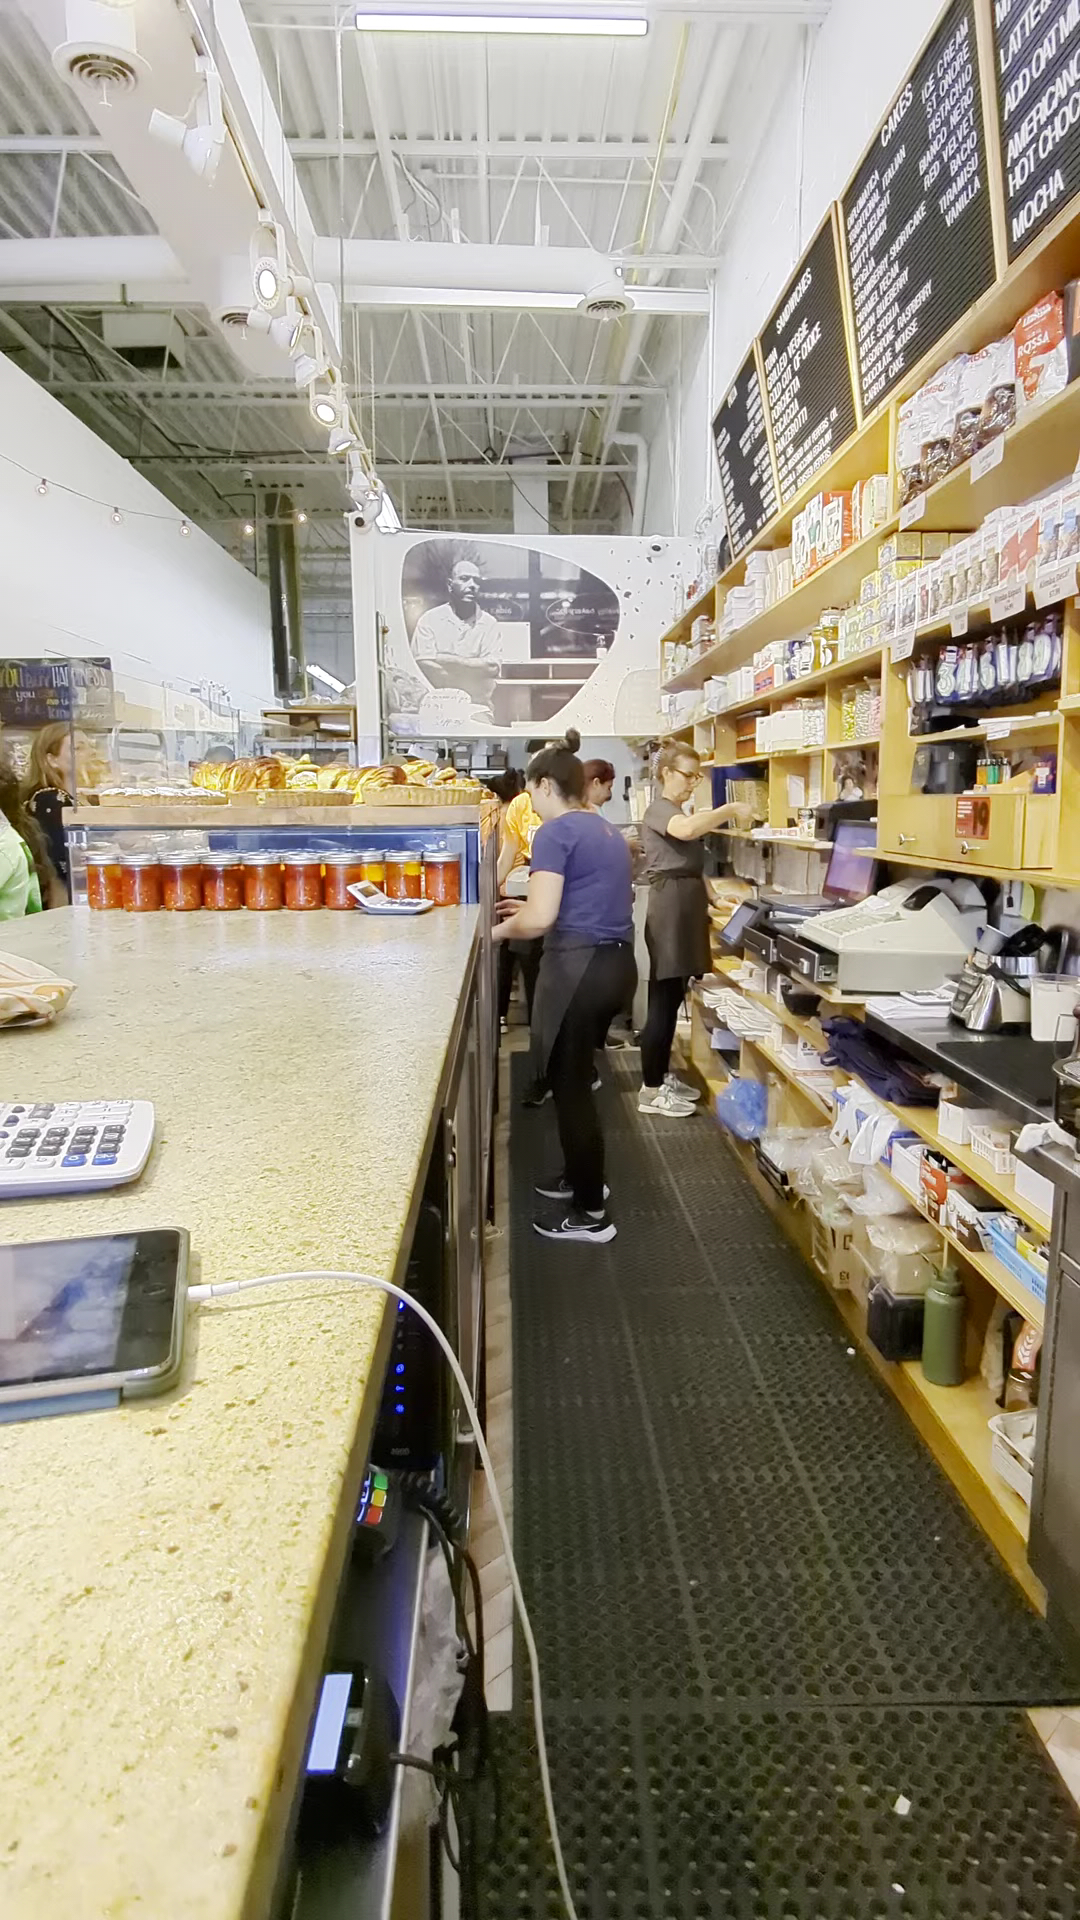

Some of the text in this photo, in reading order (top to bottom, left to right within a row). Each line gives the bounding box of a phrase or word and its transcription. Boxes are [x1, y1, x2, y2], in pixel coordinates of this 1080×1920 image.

[921, 16, 968, 103] ICE CREAM
[926, 40, 969, 118] ST ONORE
[1005, 67, 1029, 121] ADD
[1032, 23, 1058, 78] OAT
[881, 83, 912, 146] CAKES
[919, 86, 973, 175] BIANCO NERO
[928, 64, 971, 139] PISTACHIO
[882, 144, 905, 190] ITALIAN
[923, 107, 973, 190] RED VELVET
[949, 130, 976, 176] BACIO
[1009, 144, 1036, 197] HOT
[938, 152, 977, 213] TIRAMISU
[945, 175, 980, 226] VANILLA
[1013, 169, 1064, 242] MOCHA
[850, 190, 889, 262] LEMON DELIGHT
[854, 200, 926, 310] STRAWBERRY SHORTCAKE
[851, 244, 868, 278] NUTTY
[879, 260, 898, 294] PECAN
[776, 267, 811, 334] SANDWICHES
[857, 266, 908, 342] LEMON BLUEBERRY
[897, 279, 931, 330] RASPBERRY
[766, 317, 808, 390] GRILLED VEGGIE
[793, 350, 800, 371] OF
[801, 321, 821, 359] CHOICE
[859, 331, 875, 359] APPLE
[862, 317, 917, 389] CHOCOLATE MOUSSE
[1017, 330, 1051, 358] ROSSA
[864, 352, 904, 405] CARROT CAKE
